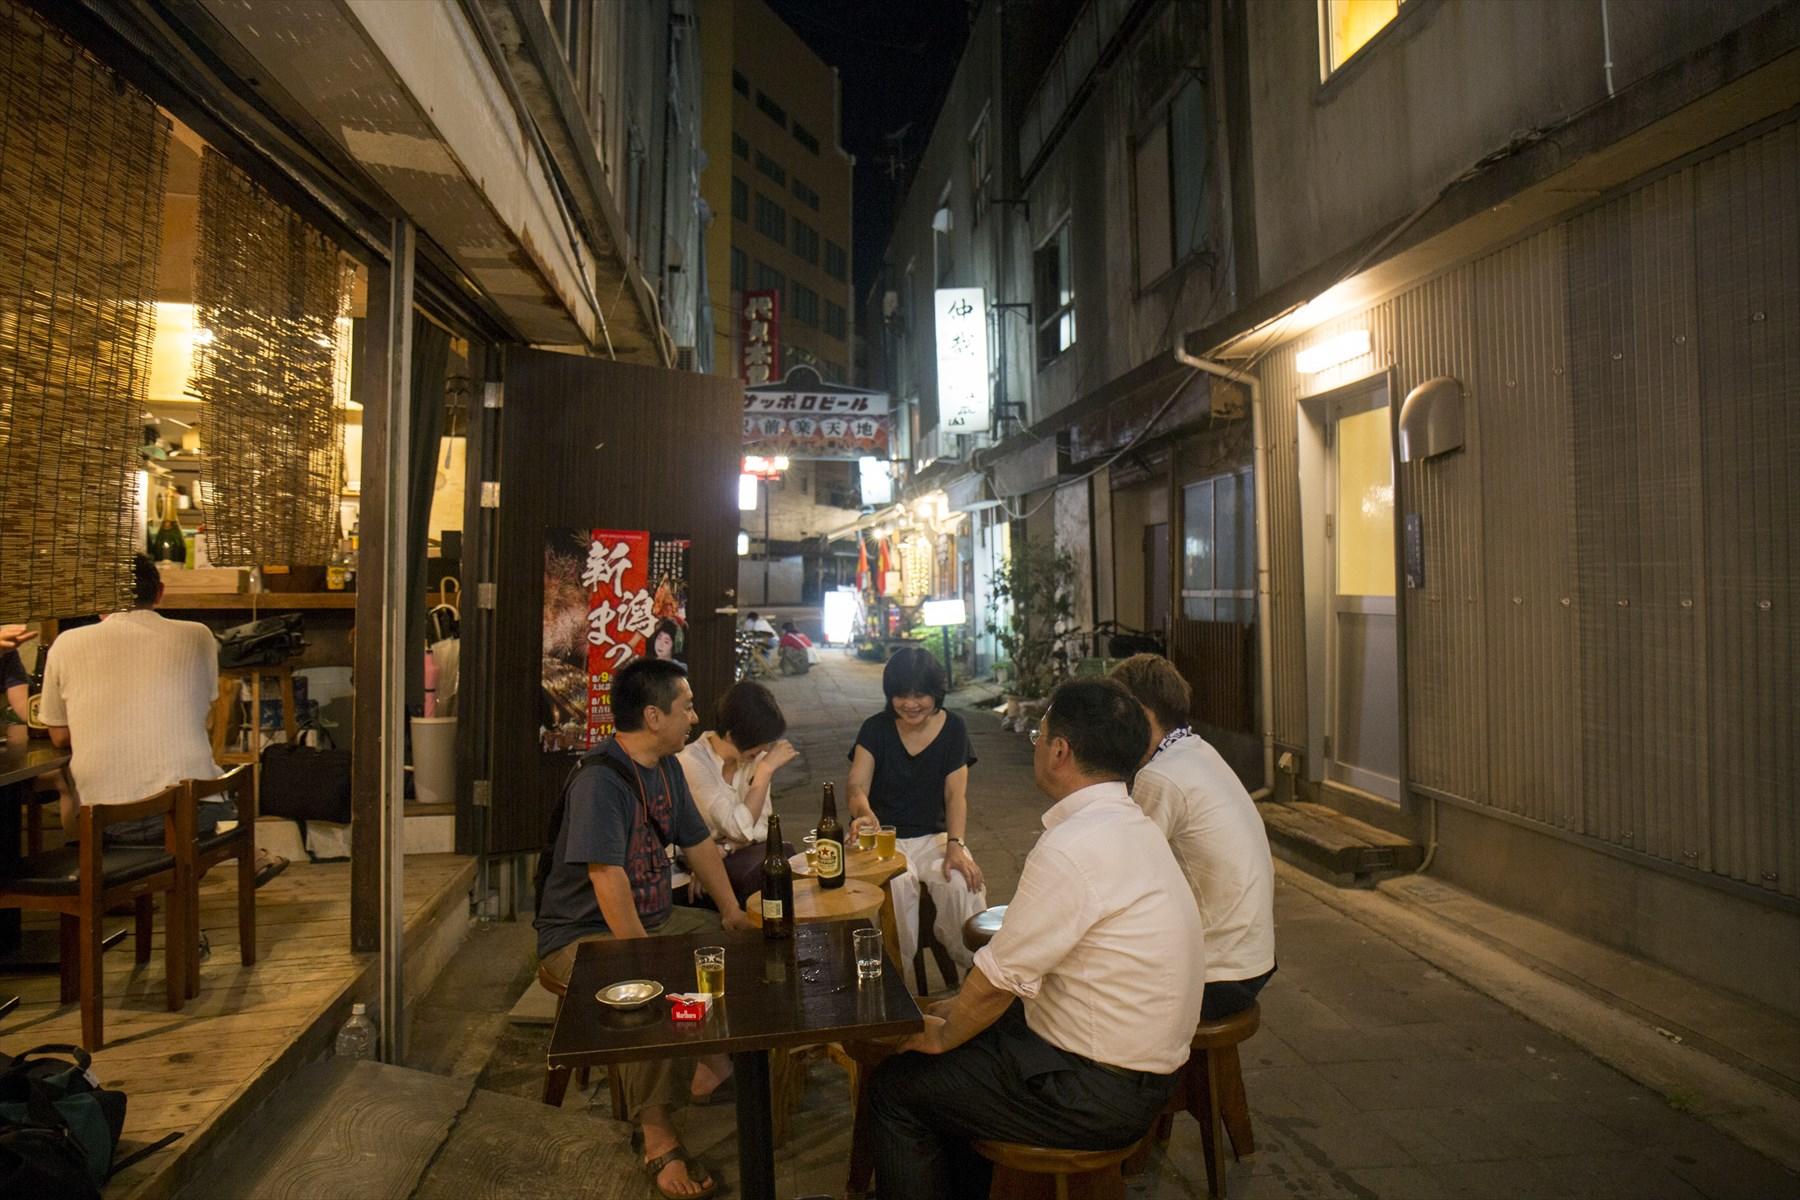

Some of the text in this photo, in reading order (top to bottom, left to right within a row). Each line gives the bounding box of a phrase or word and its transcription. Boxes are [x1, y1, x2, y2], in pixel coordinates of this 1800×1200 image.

[744, 394, 869, 411] サッポロビール
